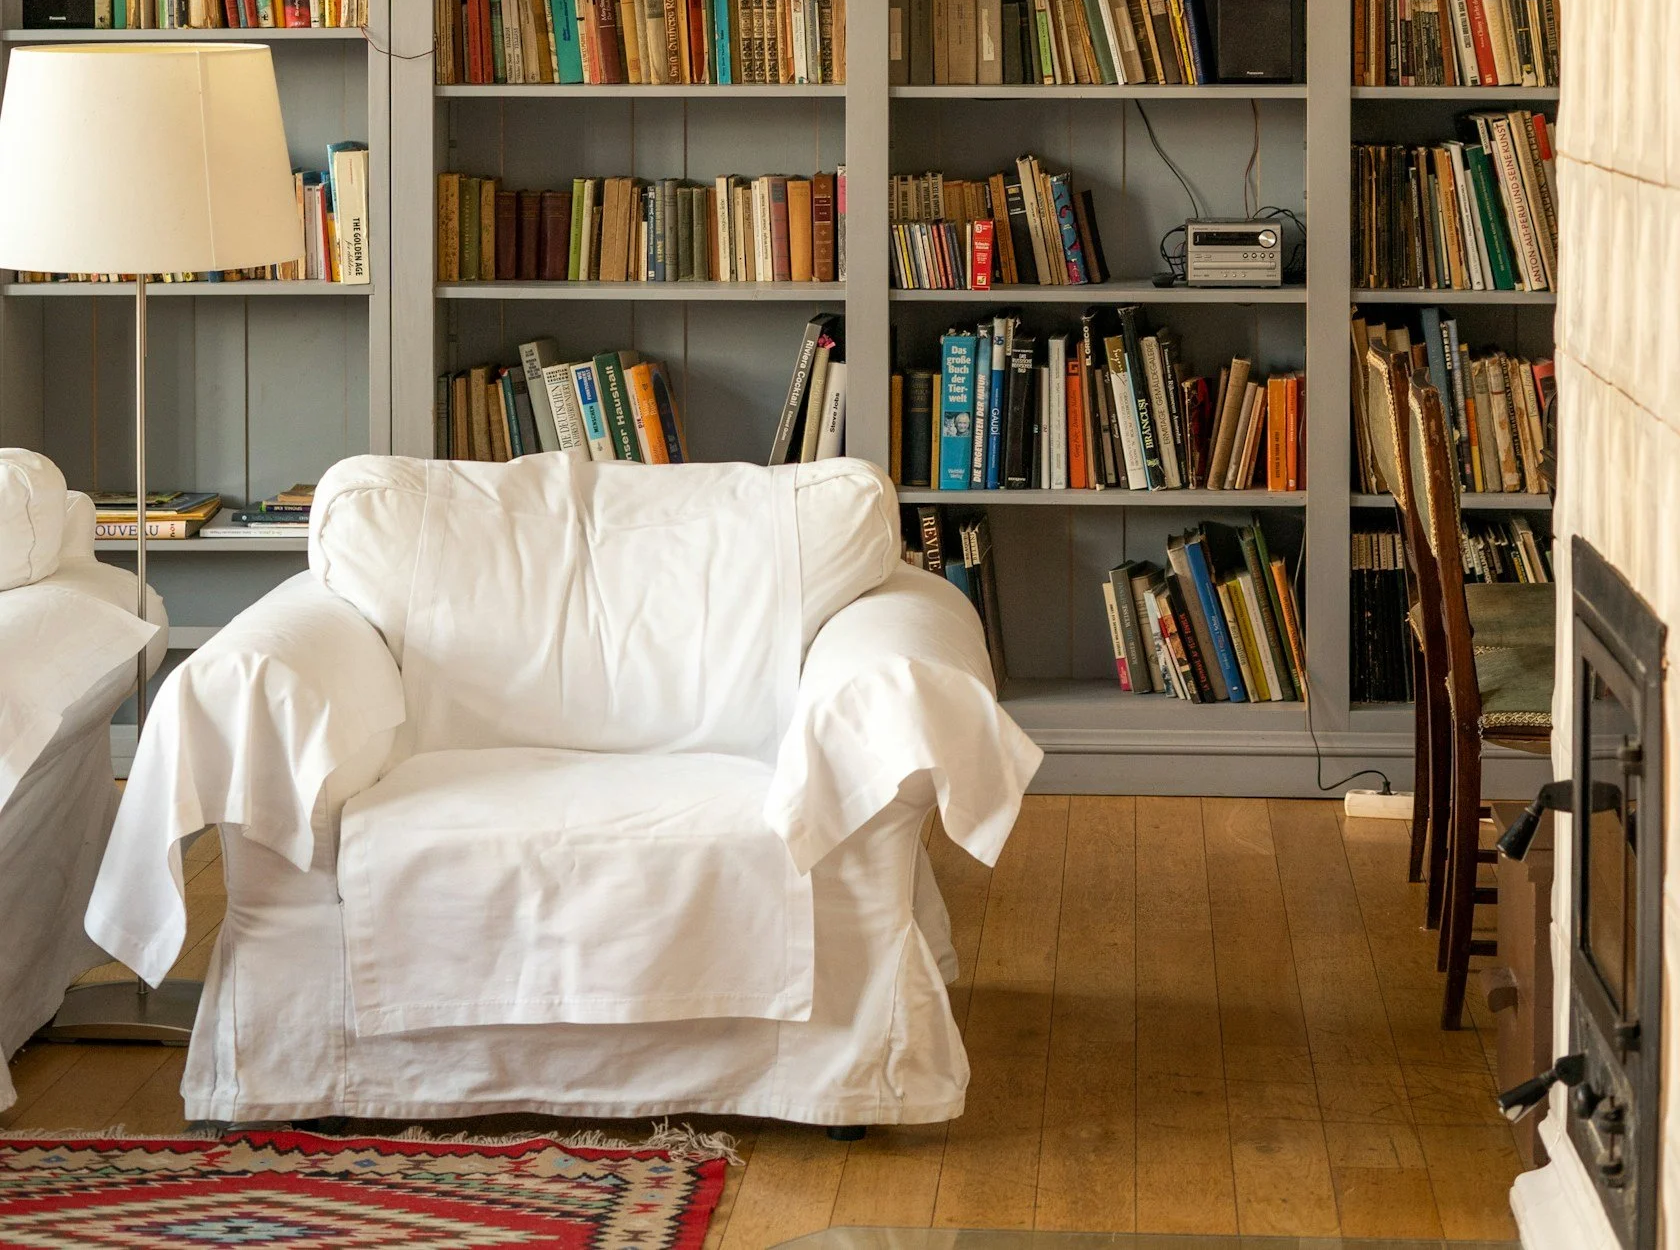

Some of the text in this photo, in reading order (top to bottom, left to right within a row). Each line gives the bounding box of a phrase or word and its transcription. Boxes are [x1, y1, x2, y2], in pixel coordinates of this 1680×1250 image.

[1495, 122, 1510, 153] KUNST
[1502, 153, 1517, 181] SEINE
[1510, 181, 1523, 204] UND
[352, 217, 363, 276] THE GOLDEN AGE
[951, 346, 967, 355] Das
[1082, 324, 1091, 366] EL GRECO
[789, 339, 814, 406] Riviera Cocktail
[946, 356, 972, 367] große
[948, 364, 970, 374] Buch
[580, 369, 592, 400] FUNKTIONIERT
[812, 378, 823, 399] Paris
[948, 384, 968, 393] Tier-
[951, 375, 966, 384] der
[561, 381, 576, 421] JAHRHUNDERT
[604, 364, 625, 426] Haushalt
[948, 394, 968, 402] welt
[549, 384, 573, 449] DIE DEUTSCHEN
[588, 404, 598, 432] MENSCHEN
[784, 410, 793, 427] Edward
[829, 391, 840, 432] Steve Jobs
[569, 421, 580, 439] IHREM
[972, 373, 985, 482] DIE URGEWALTEN DER NATUR
[1172, 414, 1182, 444] Amsterdam
[922, 516, 941, 570] REVUE
[1120, 603, 1131, 627] WEISSE
